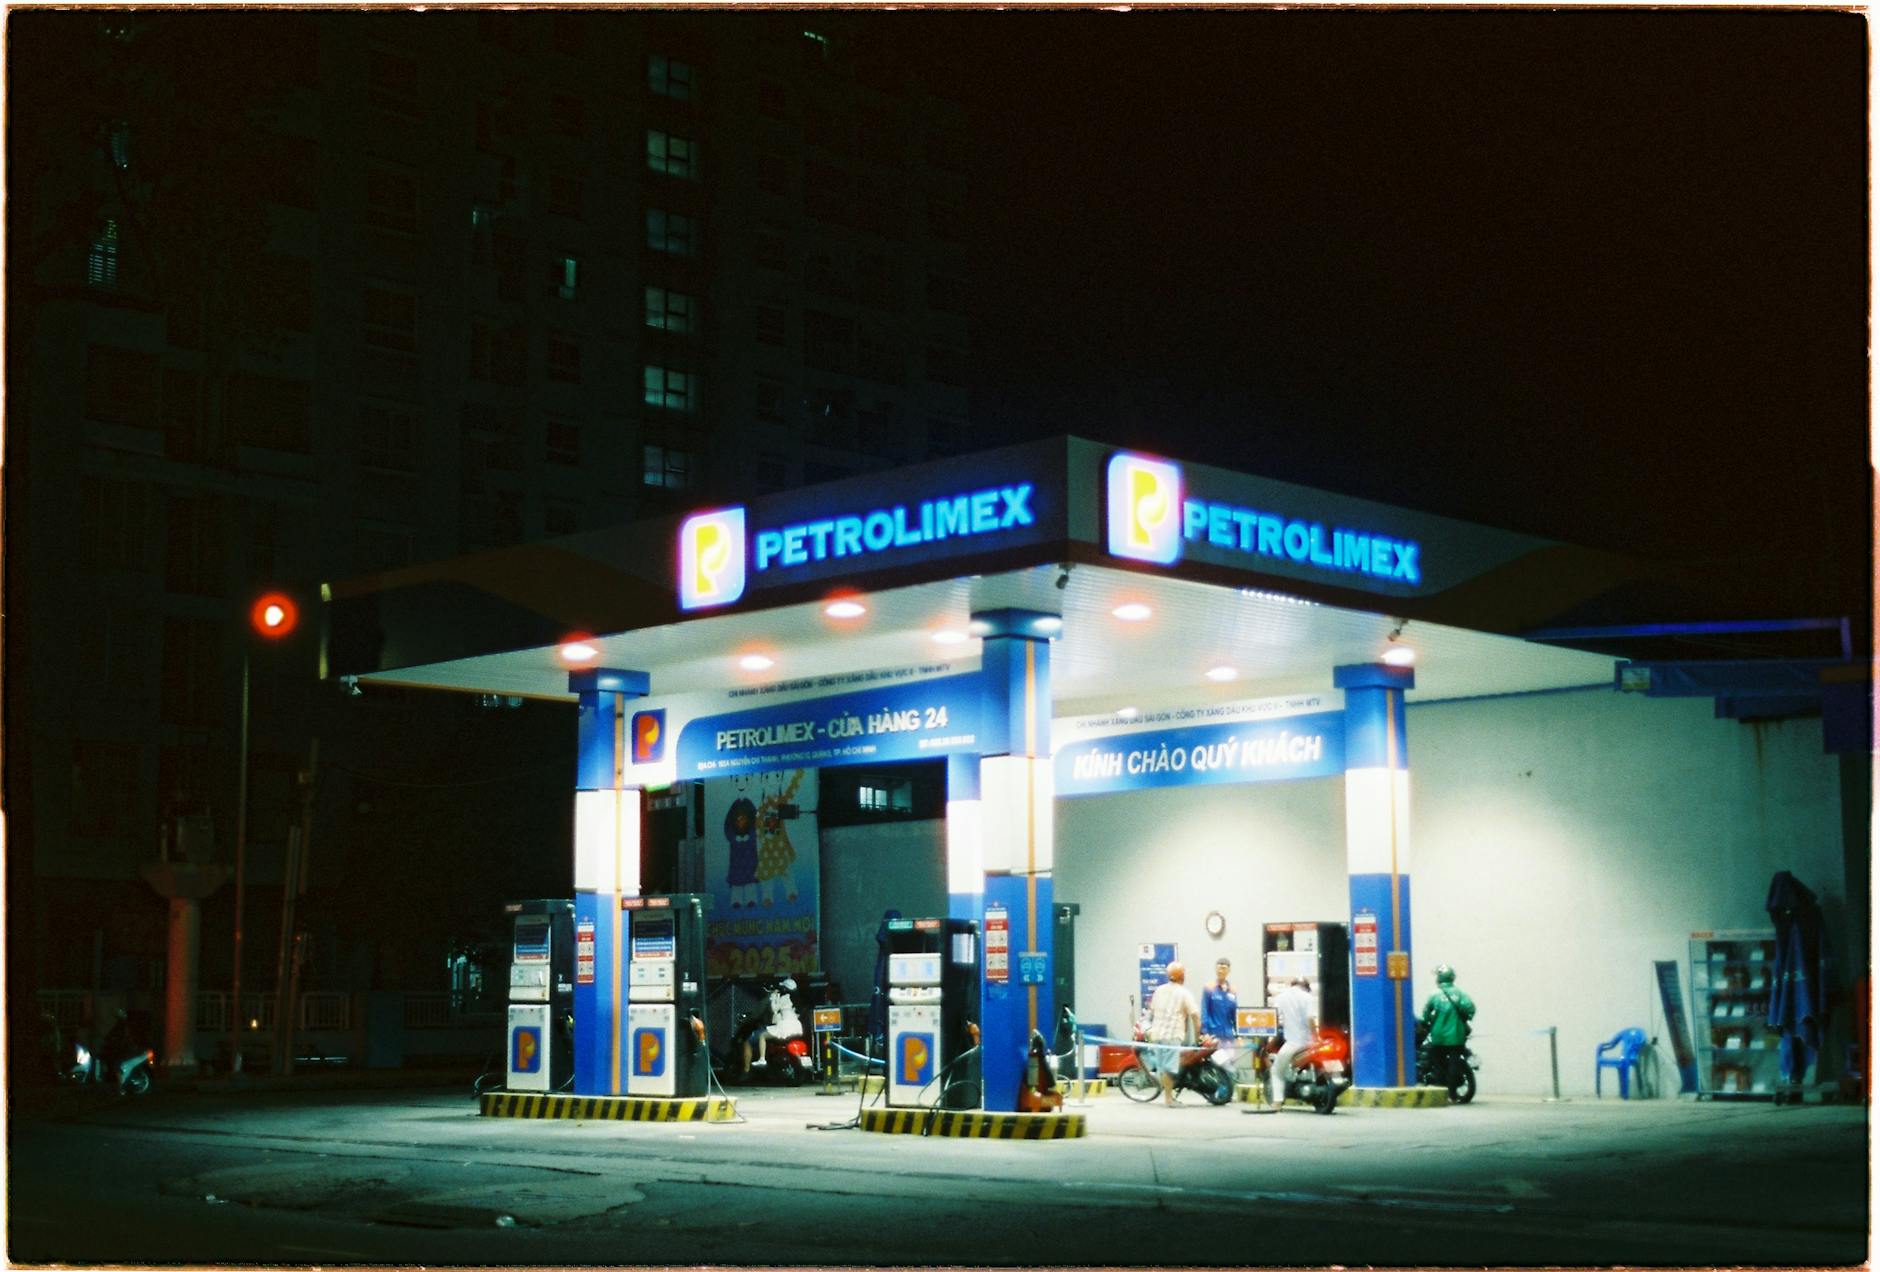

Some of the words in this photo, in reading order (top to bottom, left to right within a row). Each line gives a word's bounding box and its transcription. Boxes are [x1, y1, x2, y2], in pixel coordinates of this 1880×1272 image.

[756, 483, 1033, 569] PETROLIMEX
[1183, 500, 1419, 581] PETROLIMEX
[716, 721, 815, 750] PETROLIMEX
[828, 711, 864, 739] CỬA
[868, 707, 921, 735] HÀNG
[925, 706, 948, 729] 24
[1072, 747, 1123, 780] KÍNH
[1127, 742, 1187, 774] CHÀO
[1191, 736, 1239, 771] QUÝ
[1241, 731, 1321, 767] KHÁCH
[730, 945, 792, 974] 2025
